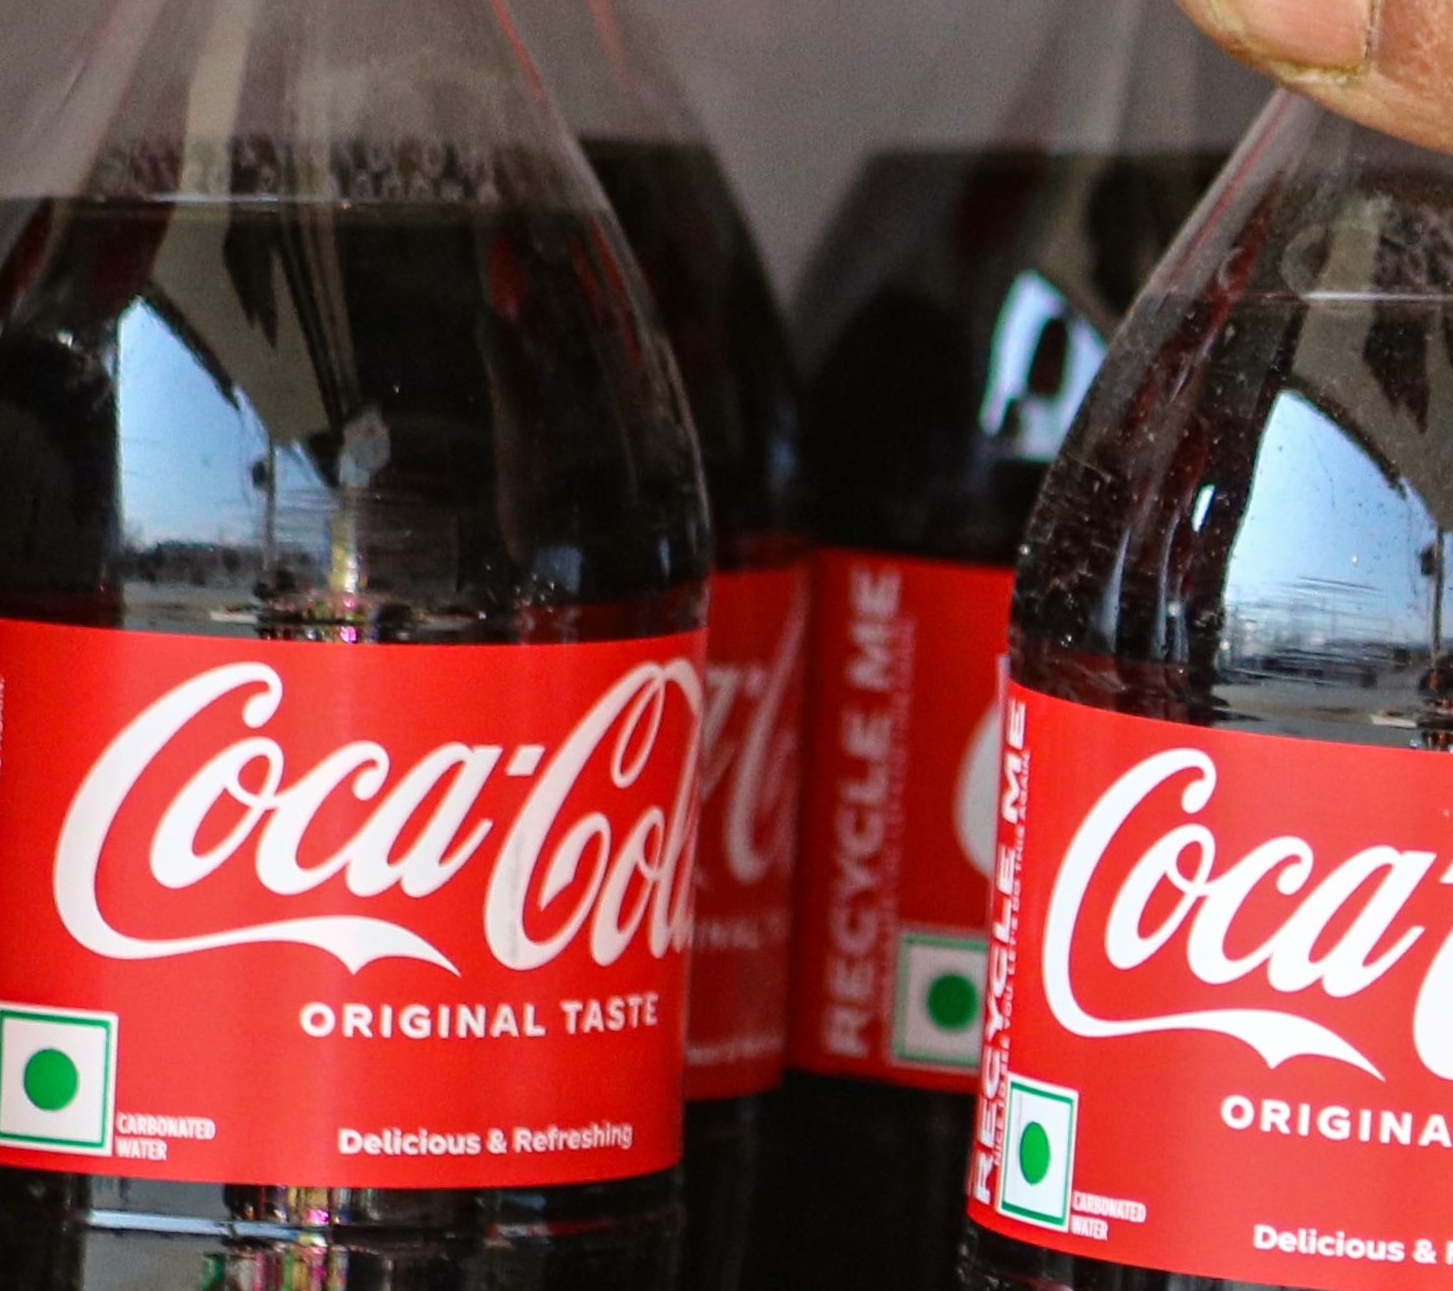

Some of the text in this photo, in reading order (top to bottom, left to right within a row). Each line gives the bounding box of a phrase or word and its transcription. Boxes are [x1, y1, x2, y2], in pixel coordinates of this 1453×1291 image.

[850, 567, 901, 690] ME
[822, 700, 891, 1057] RECYCLE
[974, 842, 1014, 1205] RECYCLE
[1002, 698, 1026, 824] ME
[299, 993, 659, 1039] ORIGINAL TASTE
[115, 1111, 216, 1140] CARBONATED
[337, 1121, 634, 1156] Delicious & Refreshing
[115, 1135, 167, 1161] WATER
[1073, 1191, 1147, 1223] CARBONATED
[1071, 1214, 1109, 1240] WATER
[1253, 1224, 1405, 1262] Delicious
[1413, 1239, 1437, 1264] &
